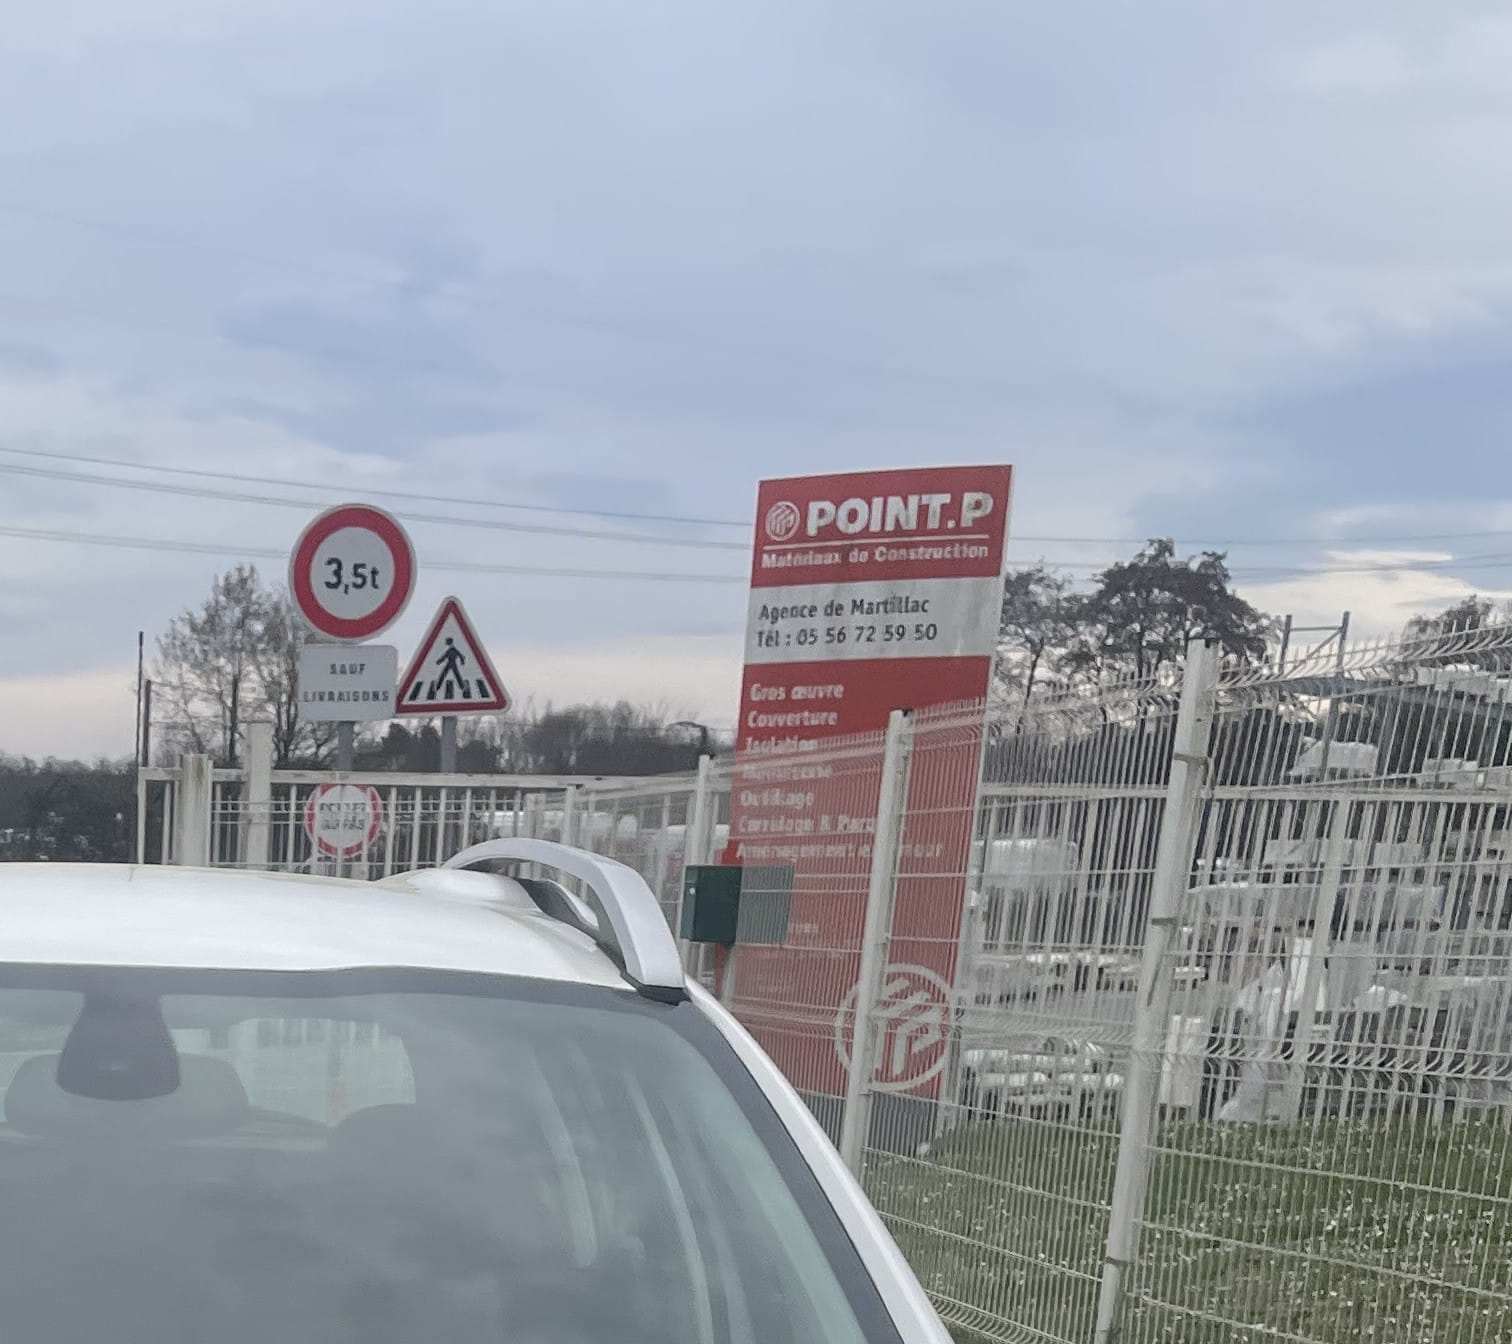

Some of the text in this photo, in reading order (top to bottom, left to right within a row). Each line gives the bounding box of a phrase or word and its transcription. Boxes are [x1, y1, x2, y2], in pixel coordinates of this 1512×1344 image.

[806, 492, 994, 537] POINT.P
[761, 543, 989, 569] Matériaux de Construction
[324, 557, 380, 595] 3,5t
[758, 594, 930, 625] Agence de Martillac
[756, 628, 780, 648] Tél
[796, 627, 818, 646] 05
[824, 625, 846, 644] 56
[855, 625, 876, 643] 72
[883, 624, 906, 642] 59
[914, 623, 938, 641] 50
[329, 663, 366, 675] SAUF
[303, 690, 390, 703] LIVRAISONS
[750, 683, 786, 701] Gros
[747, 710, 838, 728] Couverture
